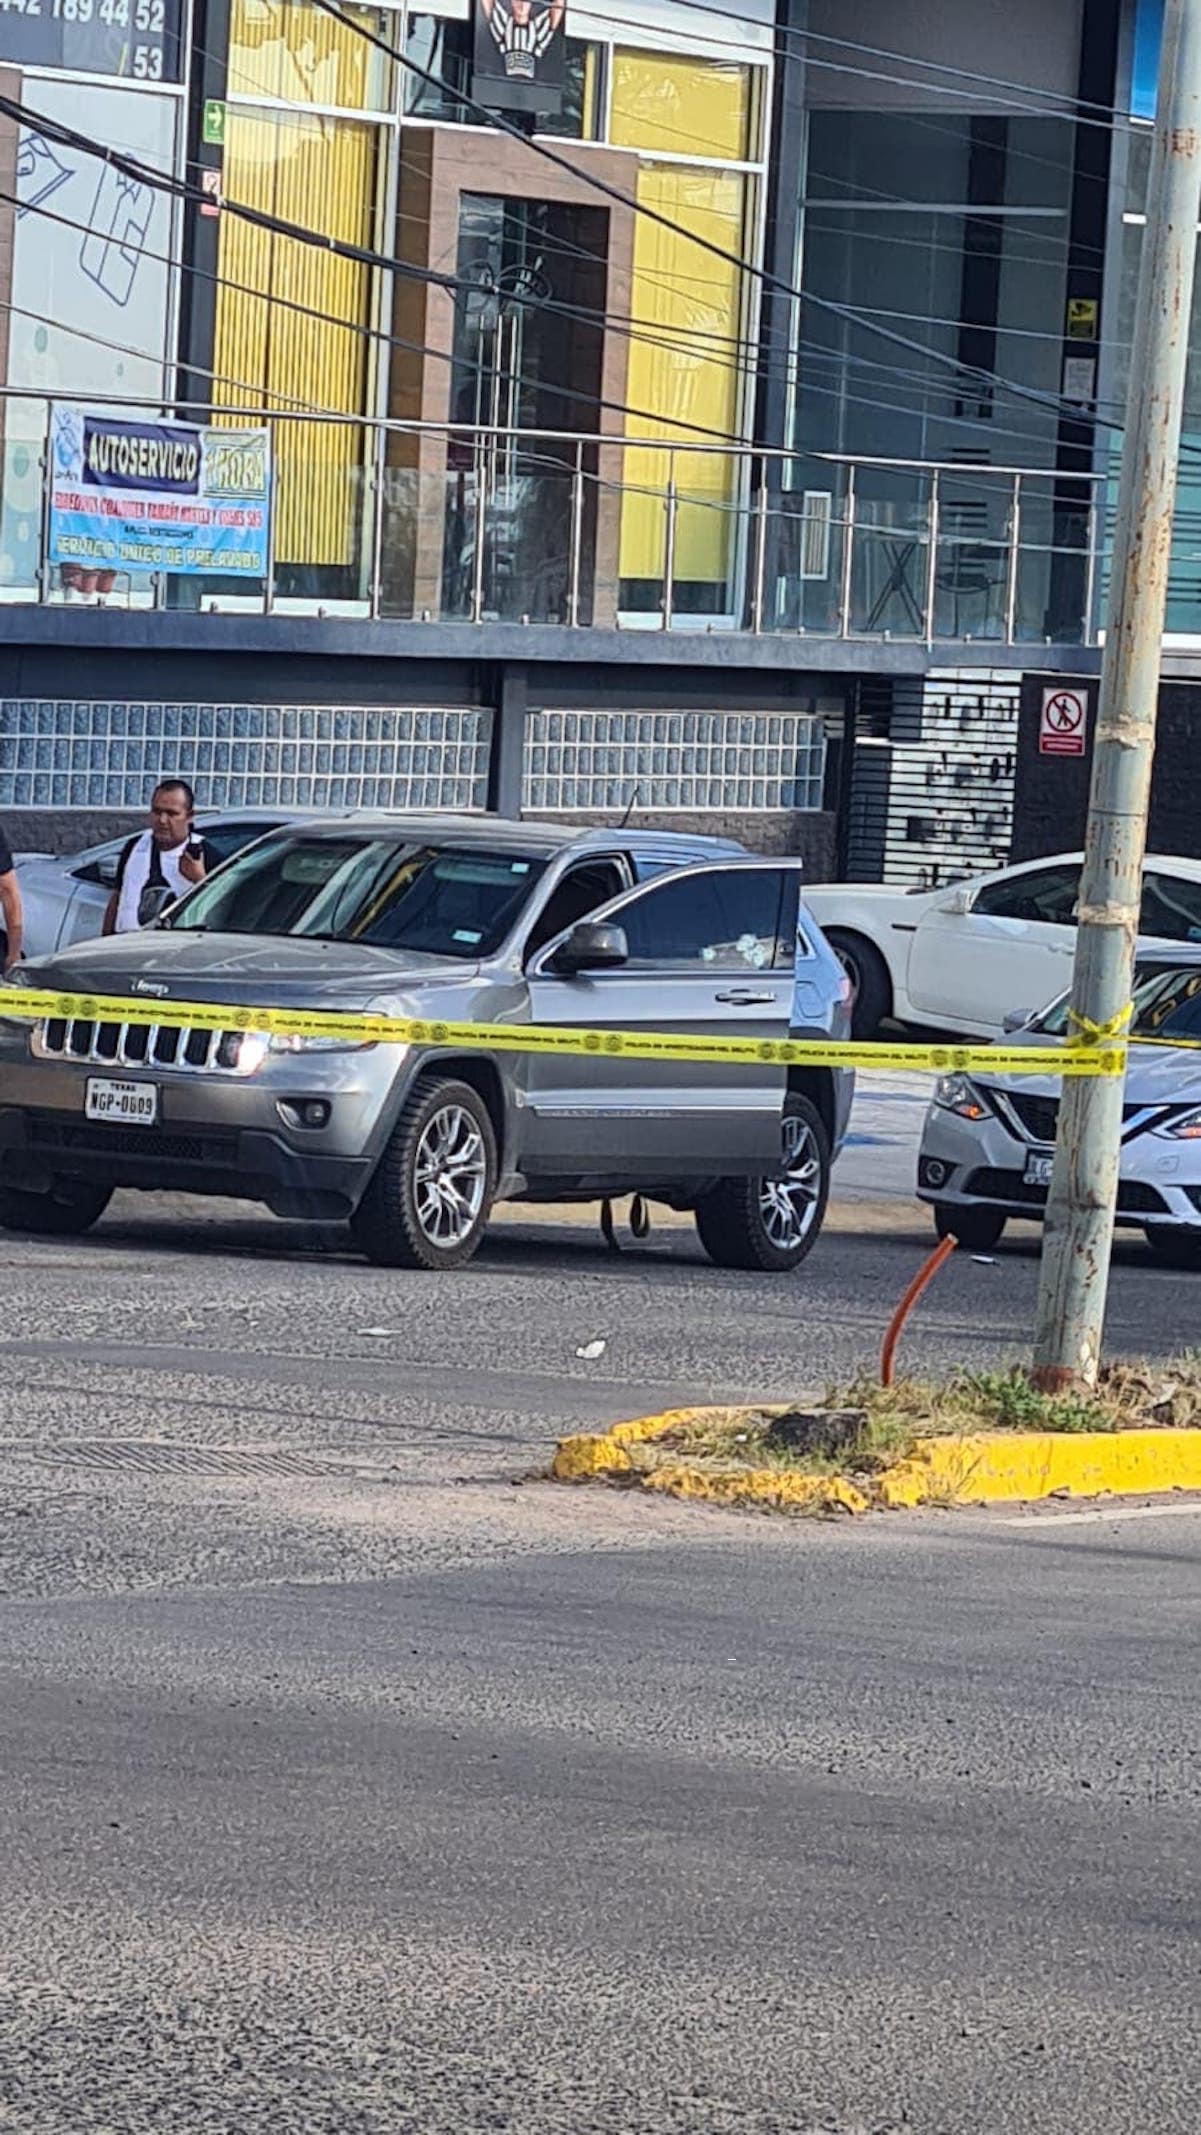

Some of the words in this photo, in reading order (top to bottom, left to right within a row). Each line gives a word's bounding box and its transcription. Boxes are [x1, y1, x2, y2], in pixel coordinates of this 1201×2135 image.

[135, 0, 165, 32] 52
[133, 45, 163, 79] 53
[88, 432, 197, 482] AUTOSERVICIO
[131, 979, 169, 998] Jeep
